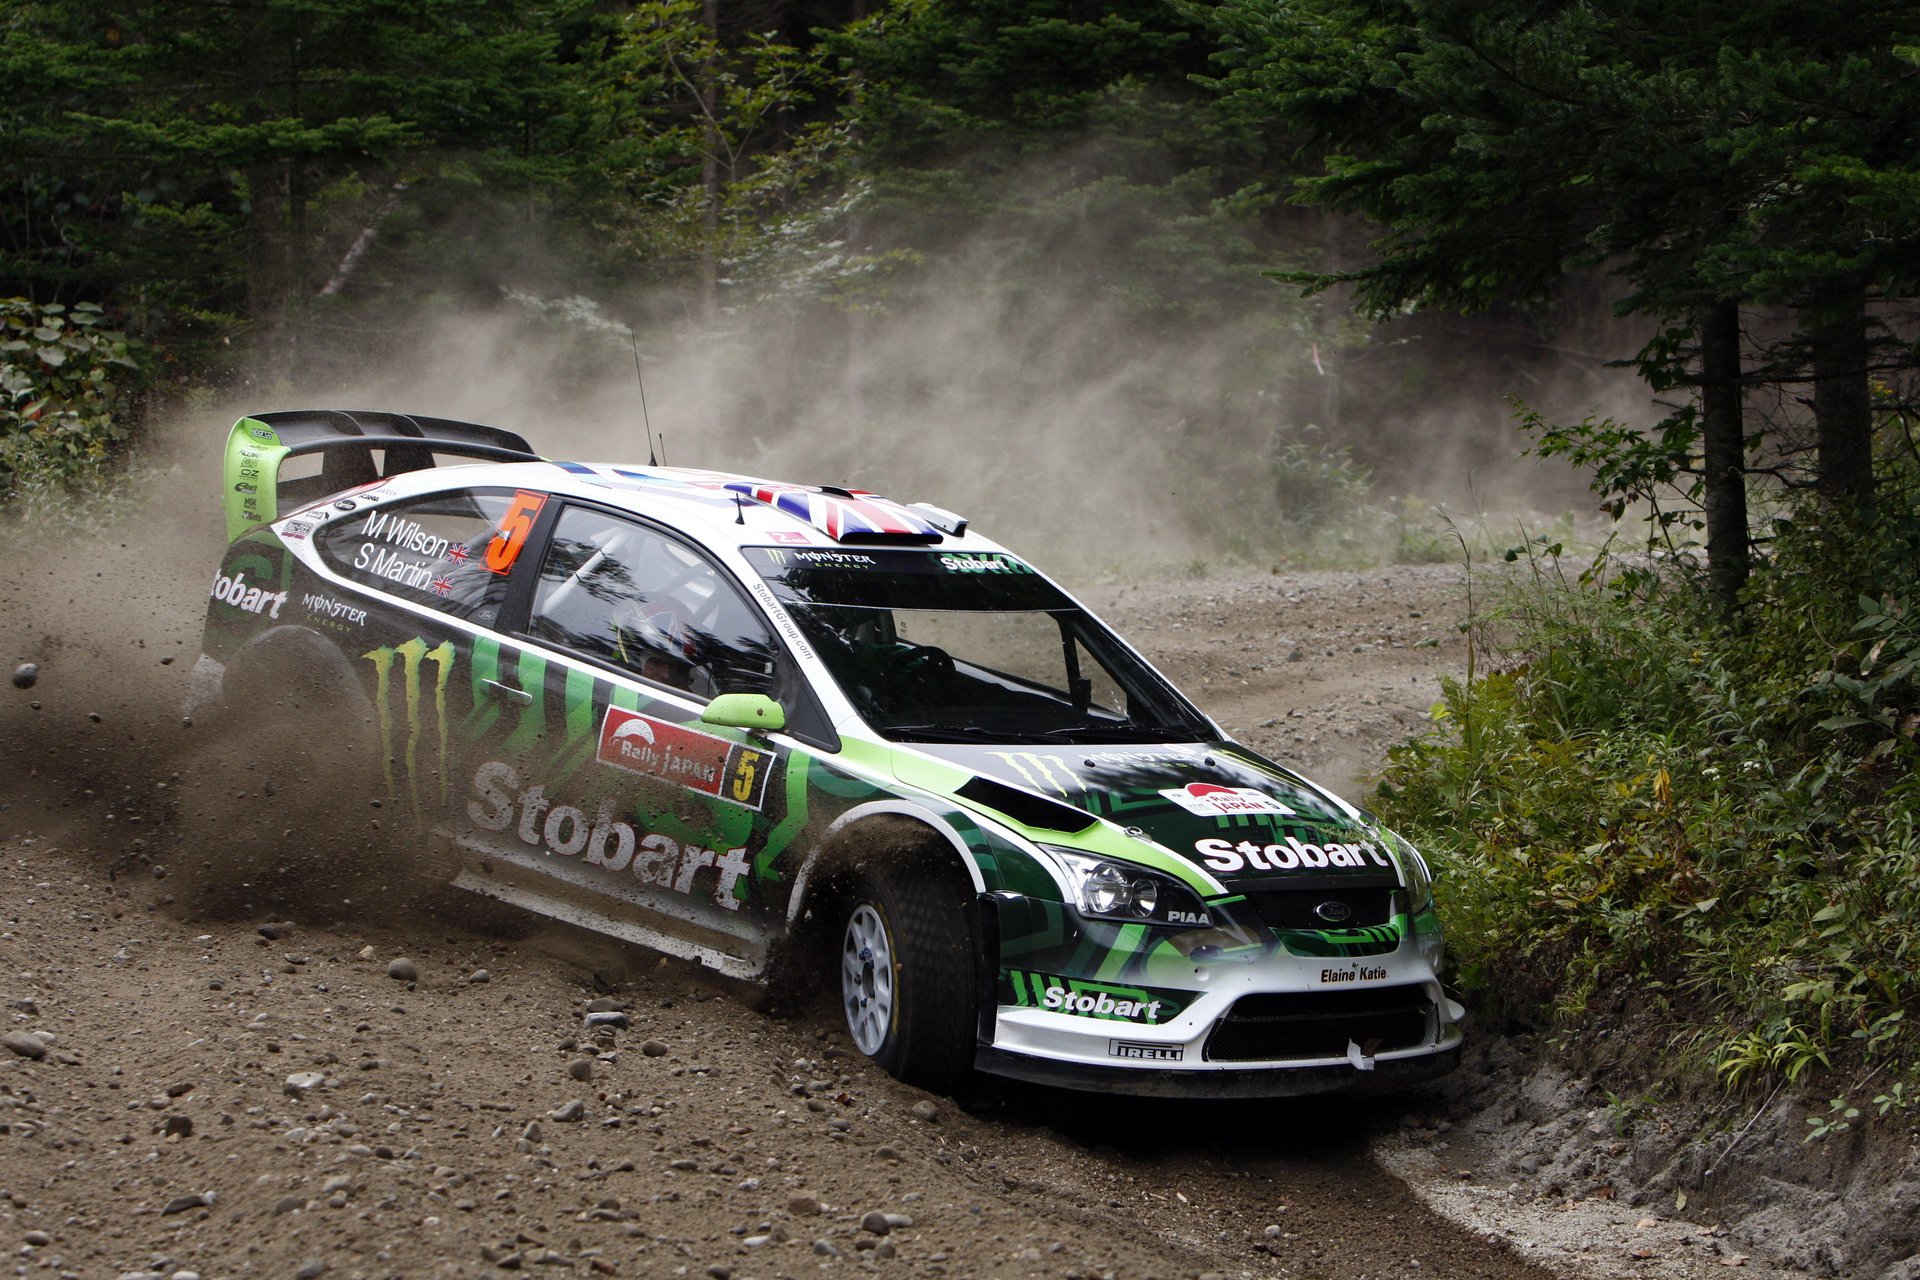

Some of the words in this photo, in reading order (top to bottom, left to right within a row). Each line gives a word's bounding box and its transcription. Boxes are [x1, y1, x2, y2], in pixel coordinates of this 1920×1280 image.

[361, 510, 388, 539] M
[386, 515, 448, 560] Wilson
[486, 492, 542, 570] 5
[354, 542, 374, 569] S
[371, 547, 433, 590] Martin
[815, 562, 868, 570] ENERGY
[940, 556, 1009, 571] Stobart
[306, 614, 352, 633] ENERGY
[753, 583, 814, 660] StobartGroup.com
[620, 739, 660, 768] Rally
[733, 750, 761, 801] 5
[1209, 795, 1247, 803] Rally
[467, 760, 751, 912] Stobart
[1194, 836, 1389, 872] Stobart
[1168, 911, 1210, 924] PIAA
[1320, 968, 1356, 983] Elaine
[1359, 966, 1387, 981] Katie
[1042, 986, 1161, 1019] Stobart
[1110, 1040, 1183, 1061] PIRELLI
